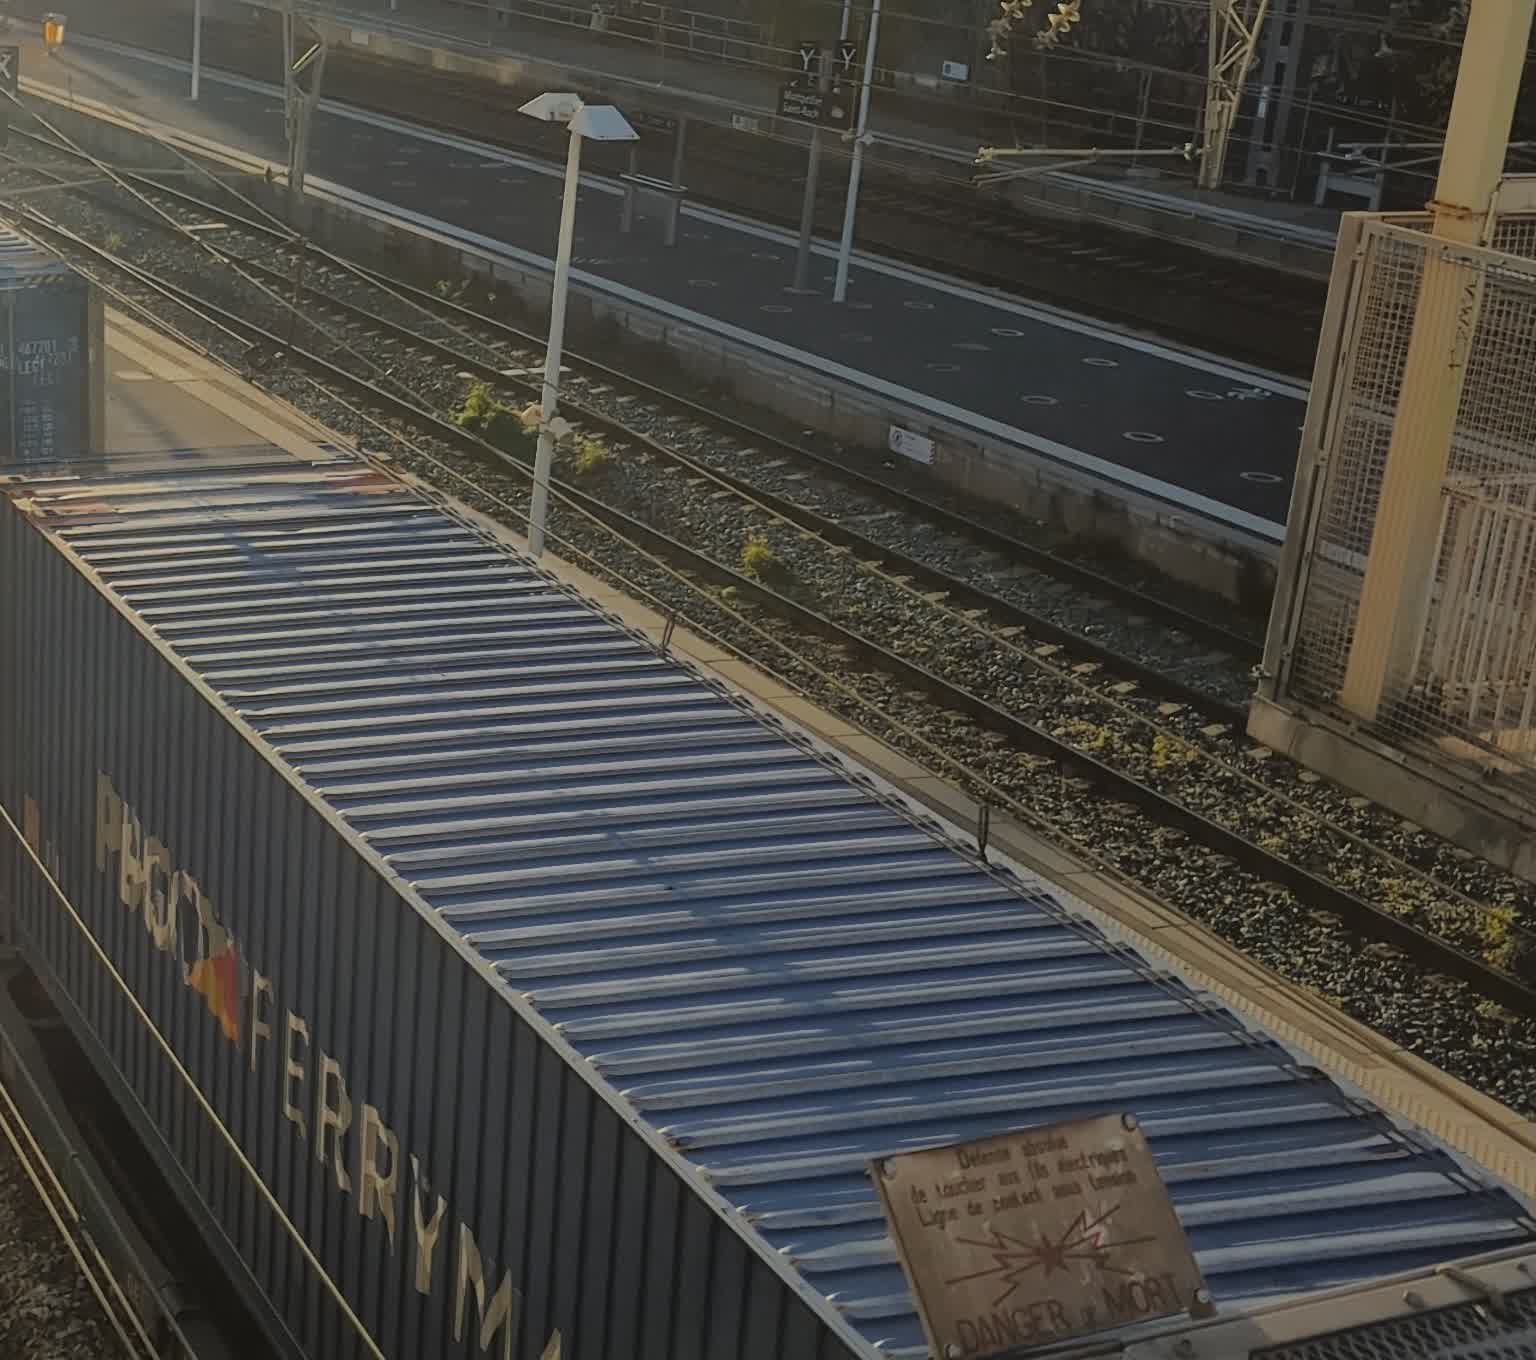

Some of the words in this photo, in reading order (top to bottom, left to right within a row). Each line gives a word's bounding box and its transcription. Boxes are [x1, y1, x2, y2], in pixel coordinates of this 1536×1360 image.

[800, 48, 816, 71] Y
[841, 48, 857, 71] Y
[956, 1299, 1072, 1353] DANGER
[1102, 1273, 1185, 1320] MORT
